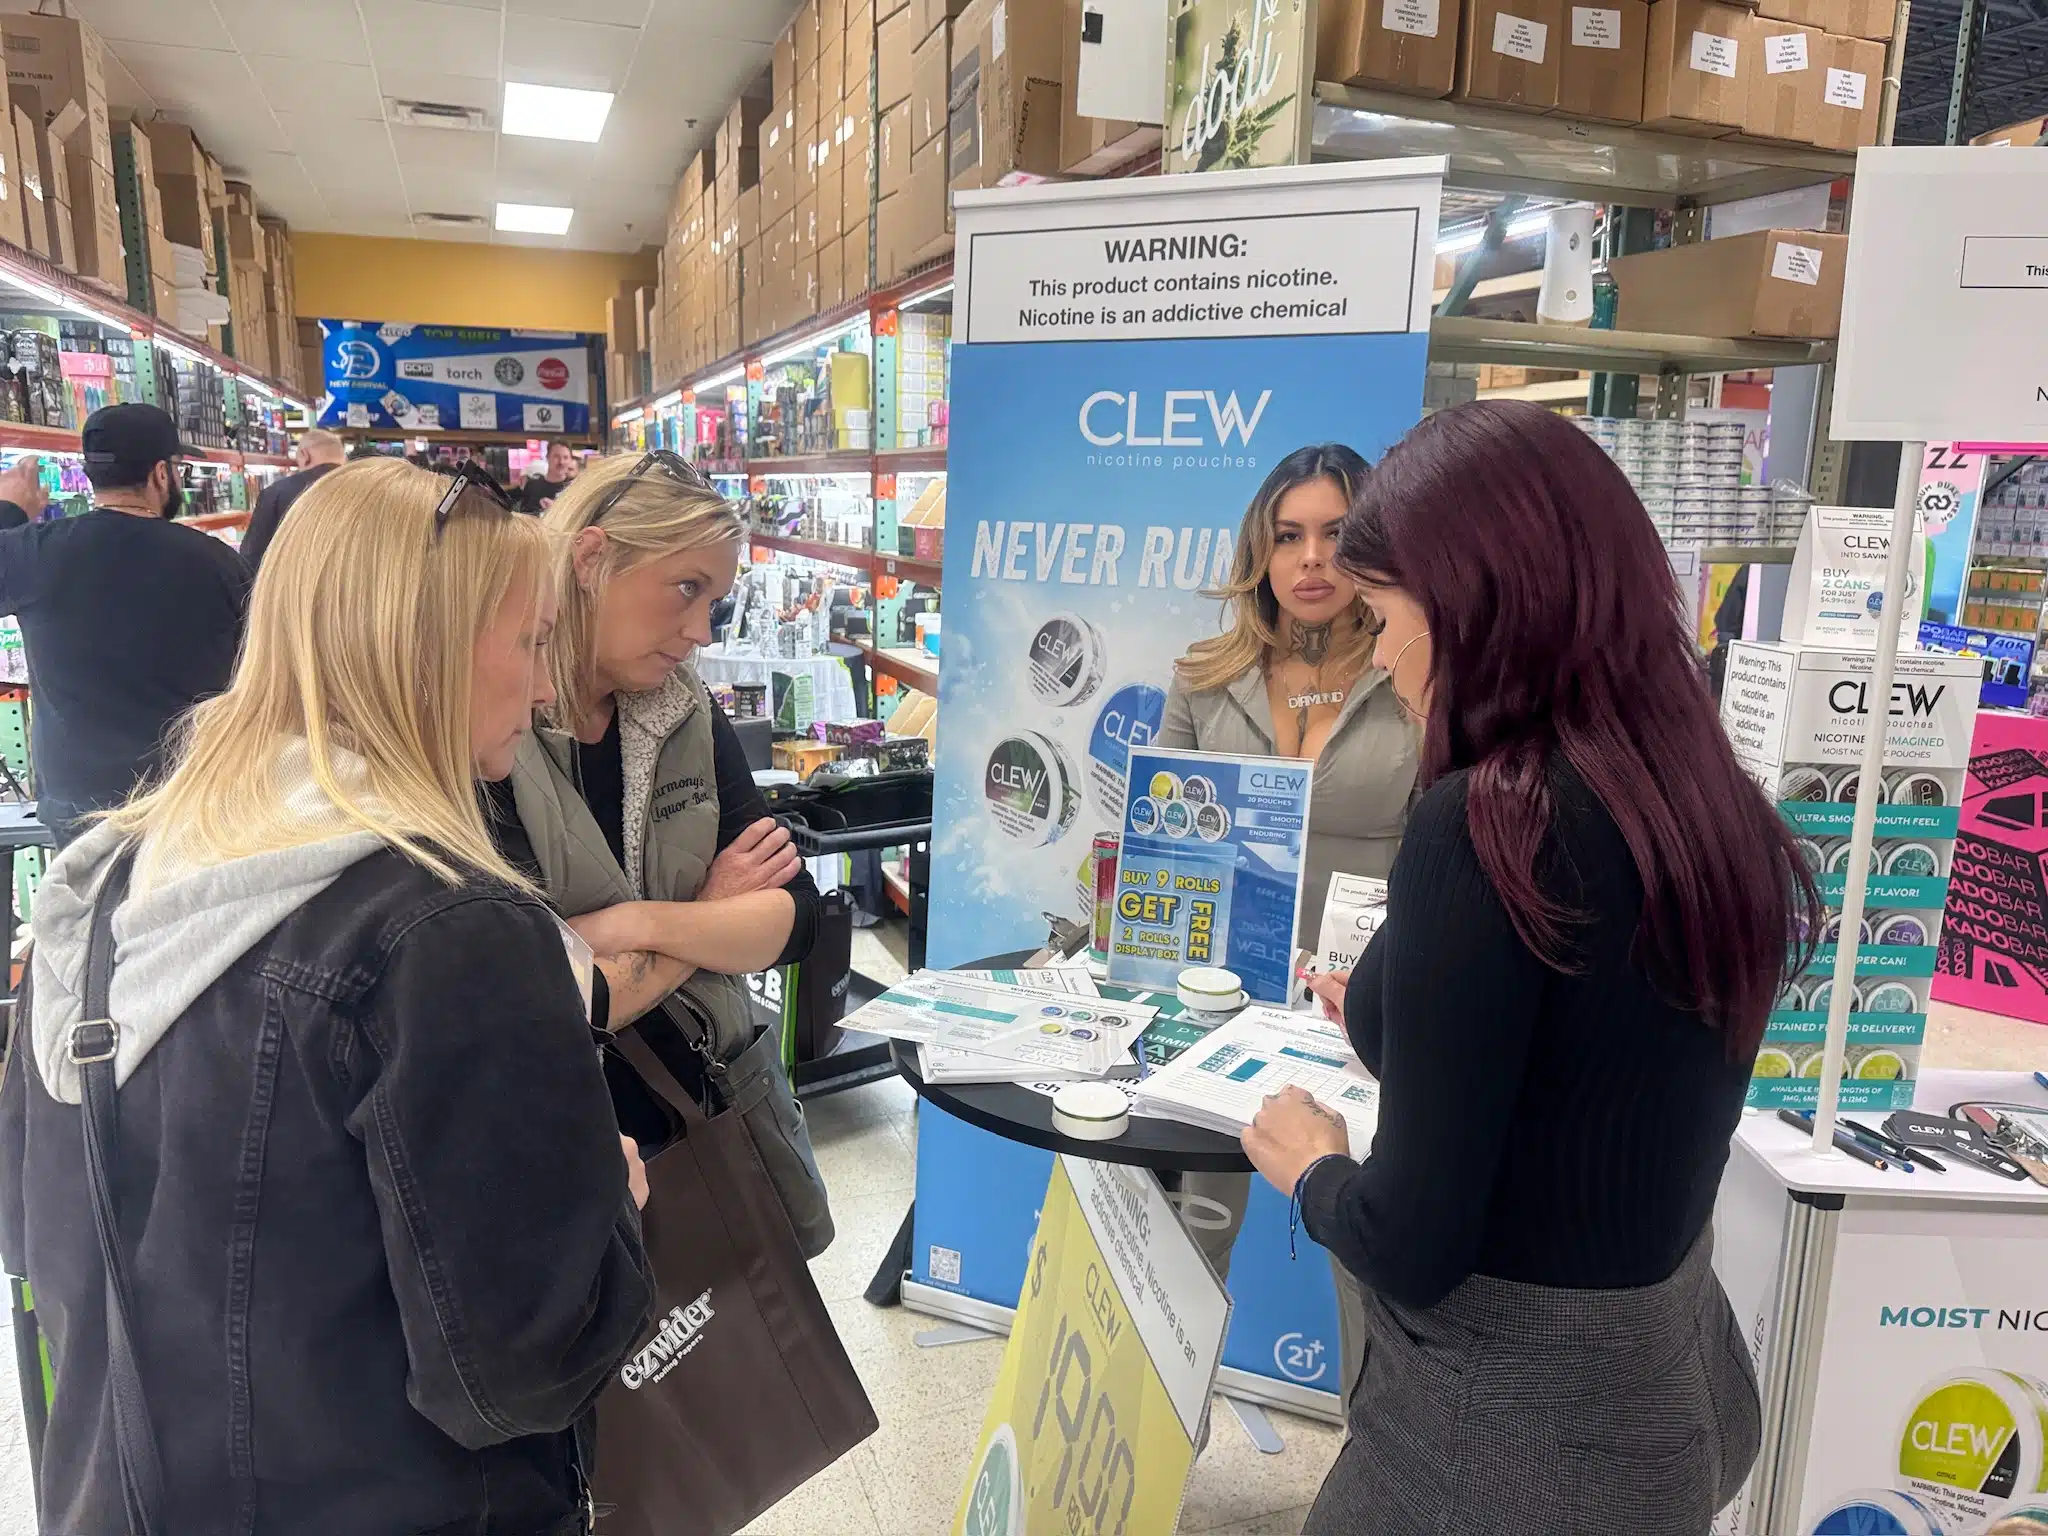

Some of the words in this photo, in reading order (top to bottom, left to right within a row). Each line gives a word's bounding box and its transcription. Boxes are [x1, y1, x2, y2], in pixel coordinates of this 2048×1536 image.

[1104, 233, 1248, 263] WARNING:
[1029, 278, 1067, 297] This
[1073, 275, 1148, 299] product
[1153, 270, 1240, 292] contains
[1246, 267, 1338, 289] nicotine.
[1018, 307, 1094, 327] Nicotine
[1101, 307, 1116, 324] is
[1122, 308, 1146, 323] an
[1151, 302, 1244, 323] addictive
[1250, 298, 1347, 320] chemical
[446, 367, 482, 381] torch
[1079, 389, 1272, 448] CLEW
[1087, 452, 1163, 467] nicotine
[1173, 454, 1257, 469] pouches
[1937, 481, 1960, 497] DUAL
[970, 519, 1125, 587] NEVER
[1840, 551, 1860, 559] INTO
[1862, 552, 1888, 560] SAVIN
[1823, 568, 1850, 578] BUY
[1821, 589, 1837, 597] FOR
[1822, 579, 1831, 588] 2
[1834, 580, 1871, 591] CANS
[1038, 632, 1072, 664] CLEW
[1738, 654, 1768, 671] Warning:
[1768, 660, 1782, 672] This
[1850, 664, 1872, 672] Nicotine
[1731, 670, 1757, 684] product
[1757, 676, 1786, 690] contains
[1741, 688, 1769, 702] nicotine.
[1732, 700, 1759, 716] Nicotine
[1760, 706, 1765, 718] is
[1766, 711, 1775, 720] an
[1735, 719, 1766, 735] addictive
[1831, 716, 1864, 727] nicoti
[1884, 736, 1944, 747] -IMAGINED
[1822, 747, 1849, 756] MOIST
[1890, 750, 1931, 759] POUCHES
[991, 762, 1041, 792] CLEW
[1250, 773, 1305, 791] CLEW
[652, 776, 704, 799] armony's
[1257, 797, 1292, 806] POUCHES
[1269, 815, 1302, 825] SMOOTH
[1794, 813, 1826, 823] ULTRA
[1875, 816, 1911, 826] MOUTH
[1912, 818, 1940, 827] FEEL!
[1248, 829, 1287, 839] ENDURING
[1955, 837, 2032, 876] DOBAR
[1897, 858, 1932, 873] CLEW
[1121, 870, 1150, 886] BUY
[1155, 868, 1170, 888] 9
[1174, 874, 1221, 894] ROLLS
[1873, 887, 1919, 898] FLAVOR!
[1949, 876, 2044, 920] ADOBAR
[1119, 892, 1177, 923] GET
[1123, 926, 1133, 941] 2
[1139, 931, 1170, 945] ROLLS
[1188, 900, 1214, 961] FREE
[1887, 928, 1921, 944] CLEW
[1115, 943, 1155, 957] DISPLAY
[1156, 949, 1180, 960] BOX
[1328, 951, 1359, 965] BUY
[1856, 956, 1877, 965] PER
[1879, 957, 1907, 966] CAN!
[1861, 1024, 1916, 1034] DELIVERY!
[1770, 1086, 1813, 1094] AVAILABLE
[1908, 1124, 1945, 1135] CLEW
[1956, 1141, 1994, 1160] CLEW
[1090, 1188, 1115, 1244] addictive
[1115, 1240, 1145, 1305] chemical.
[1117, 1213, 1145, 1272] nicotine.
[1145, 1260, 1176, 1329] Nicotine
[1175, 1318, 1185, 1346] is
[1184, 1339, 1197, 1369] an
[1085, 1261, 1122, 1347] CLEW
[1879, 1306, 1990, 1329] MOIST
[652, 1359, 679, 1384] Rolling
[676, 1333, 704, 1360] Papers
[1911, 1421, 2006, 1460] CLEW
[1911, 1481, 1941, 1494] WARNING:
[1942, 1488, 1956, 1498] This
[1956, 1493, 1984, 1505] product
[1957, 1504, 1987, 1518] Nicotine
